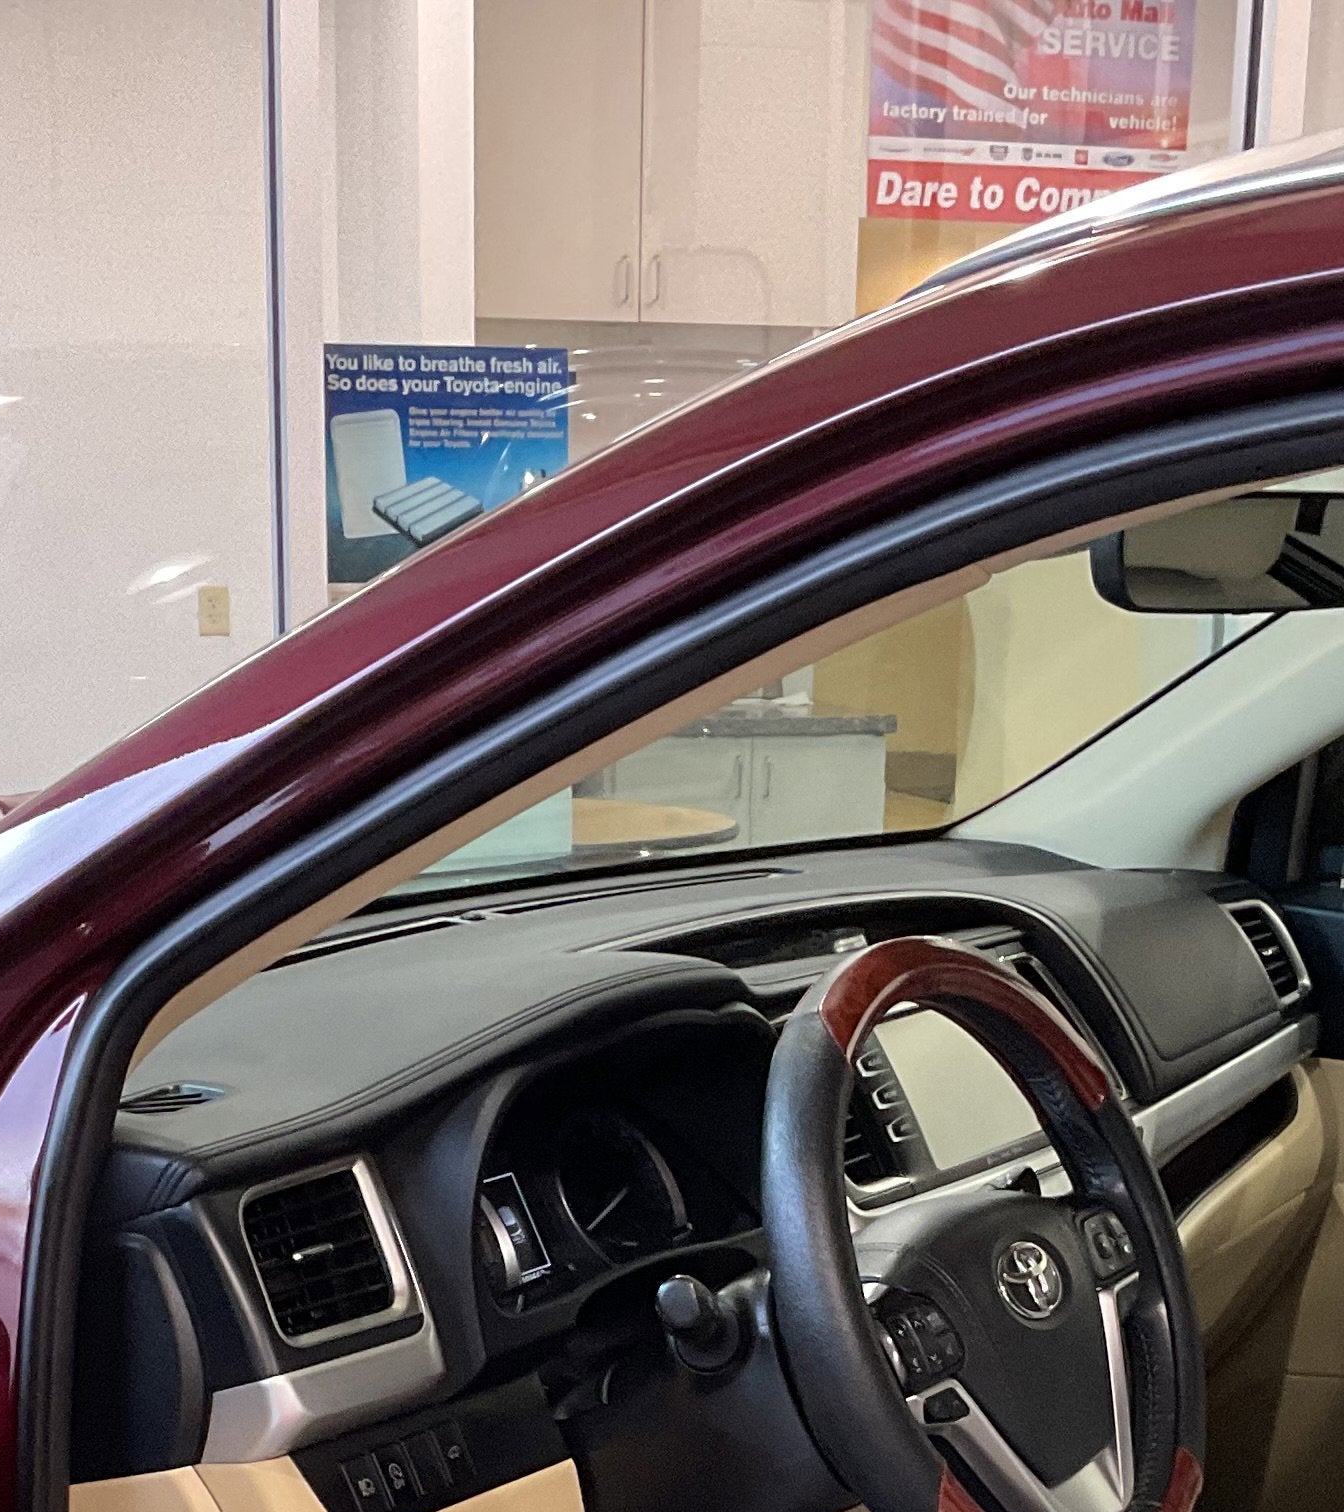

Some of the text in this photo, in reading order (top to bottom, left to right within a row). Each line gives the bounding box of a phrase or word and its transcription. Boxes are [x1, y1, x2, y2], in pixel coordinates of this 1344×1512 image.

[1042, 27, 1180, 61] SERVICE
[1003, 83, 1037, 100] Our
[1042, 86, 1145, 107] technicians
[883, 101, 1177, 132] factory trained for vehicle!
[876, 171, 1112, 213] Dare to Com
[326, 353, 562, 374] You like to breathe fresh air.
[327, 374, 351, 390] So
[356, 375, 398, 391] does
[402, 379, 441, 395] your
[443, 376, 500, 396] Toyota
